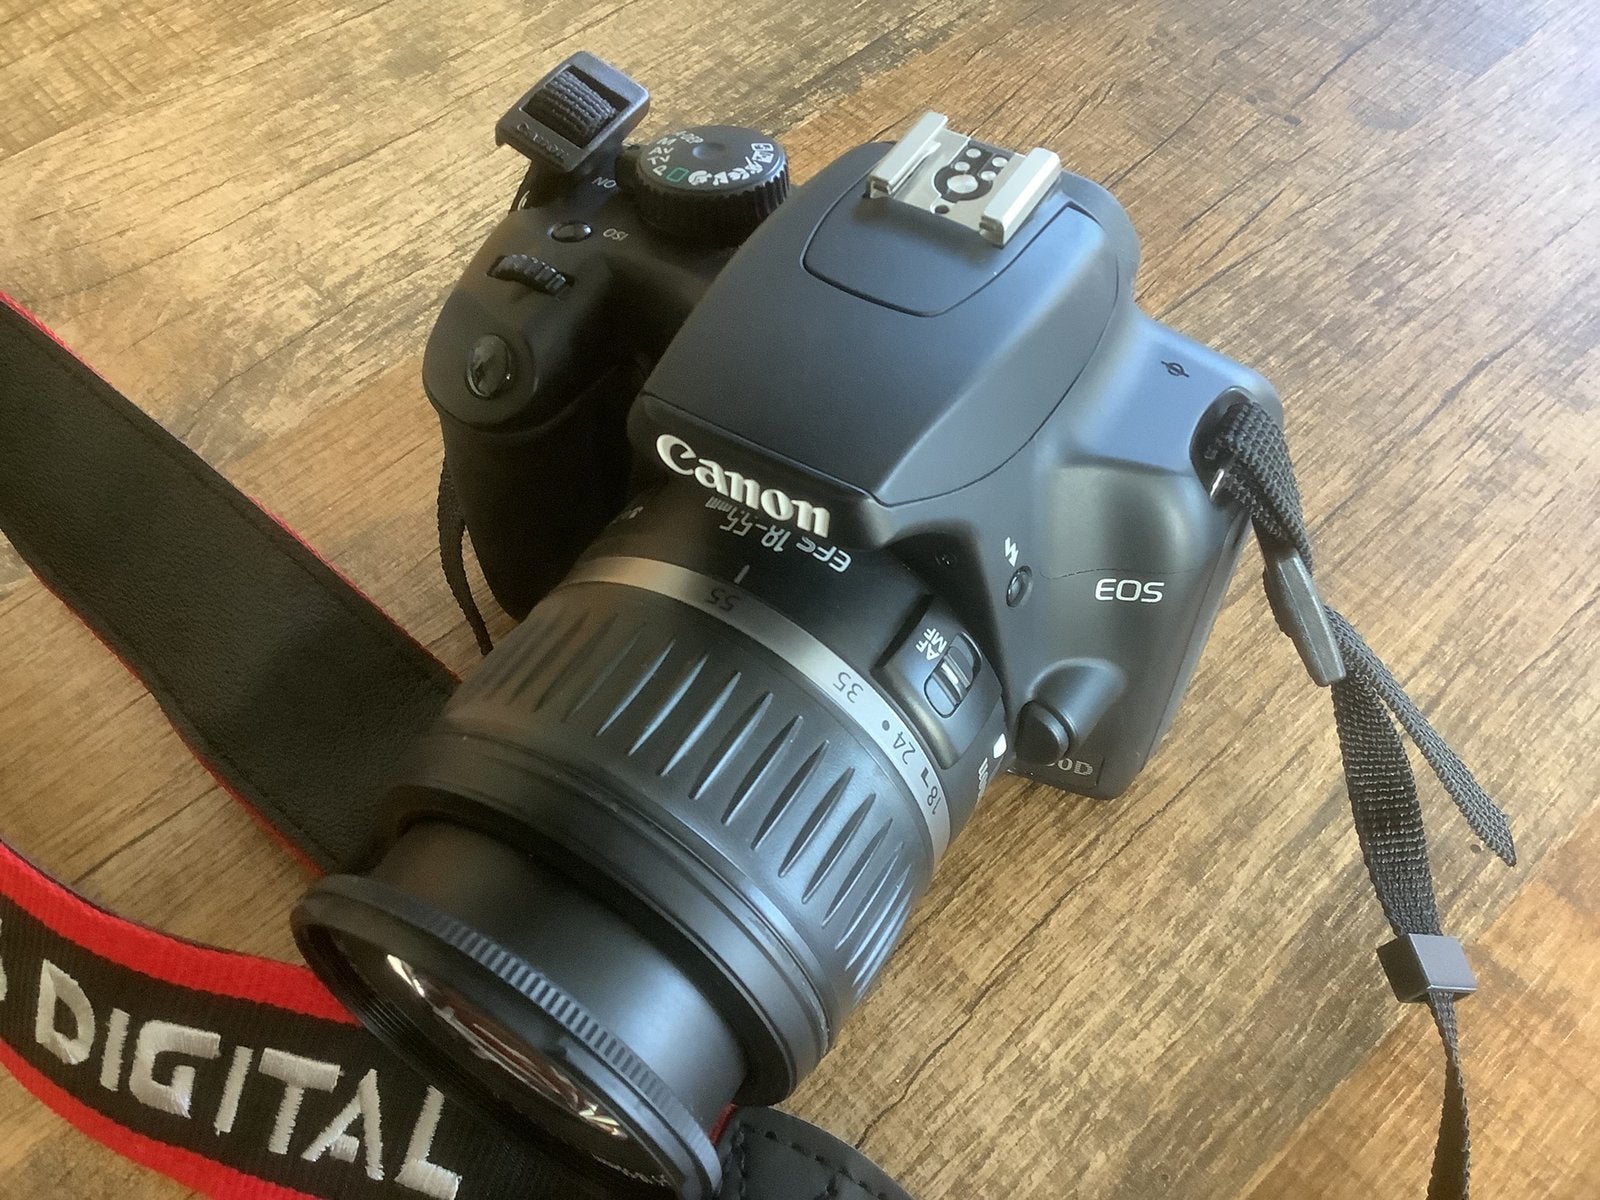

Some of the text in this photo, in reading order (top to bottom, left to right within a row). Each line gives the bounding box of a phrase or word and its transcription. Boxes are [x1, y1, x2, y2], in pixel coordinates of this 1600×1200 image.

[591, 176, 617, 189] ON
[652, 164, 668, 177] P
[603, 227, 630, 241] ISO
[656, 433, 831, 539] Canon
[1095, 578, 1166, 603] EOS
[915, 639, 940, 661] AF
[922, 627, 948, 652] MF
[832, 670, 865, 704] 35
[893, 730, 917, 766] 24
[926, 785, 943, 816] 18
[34, 957, 464, 1200] DIGITAL
